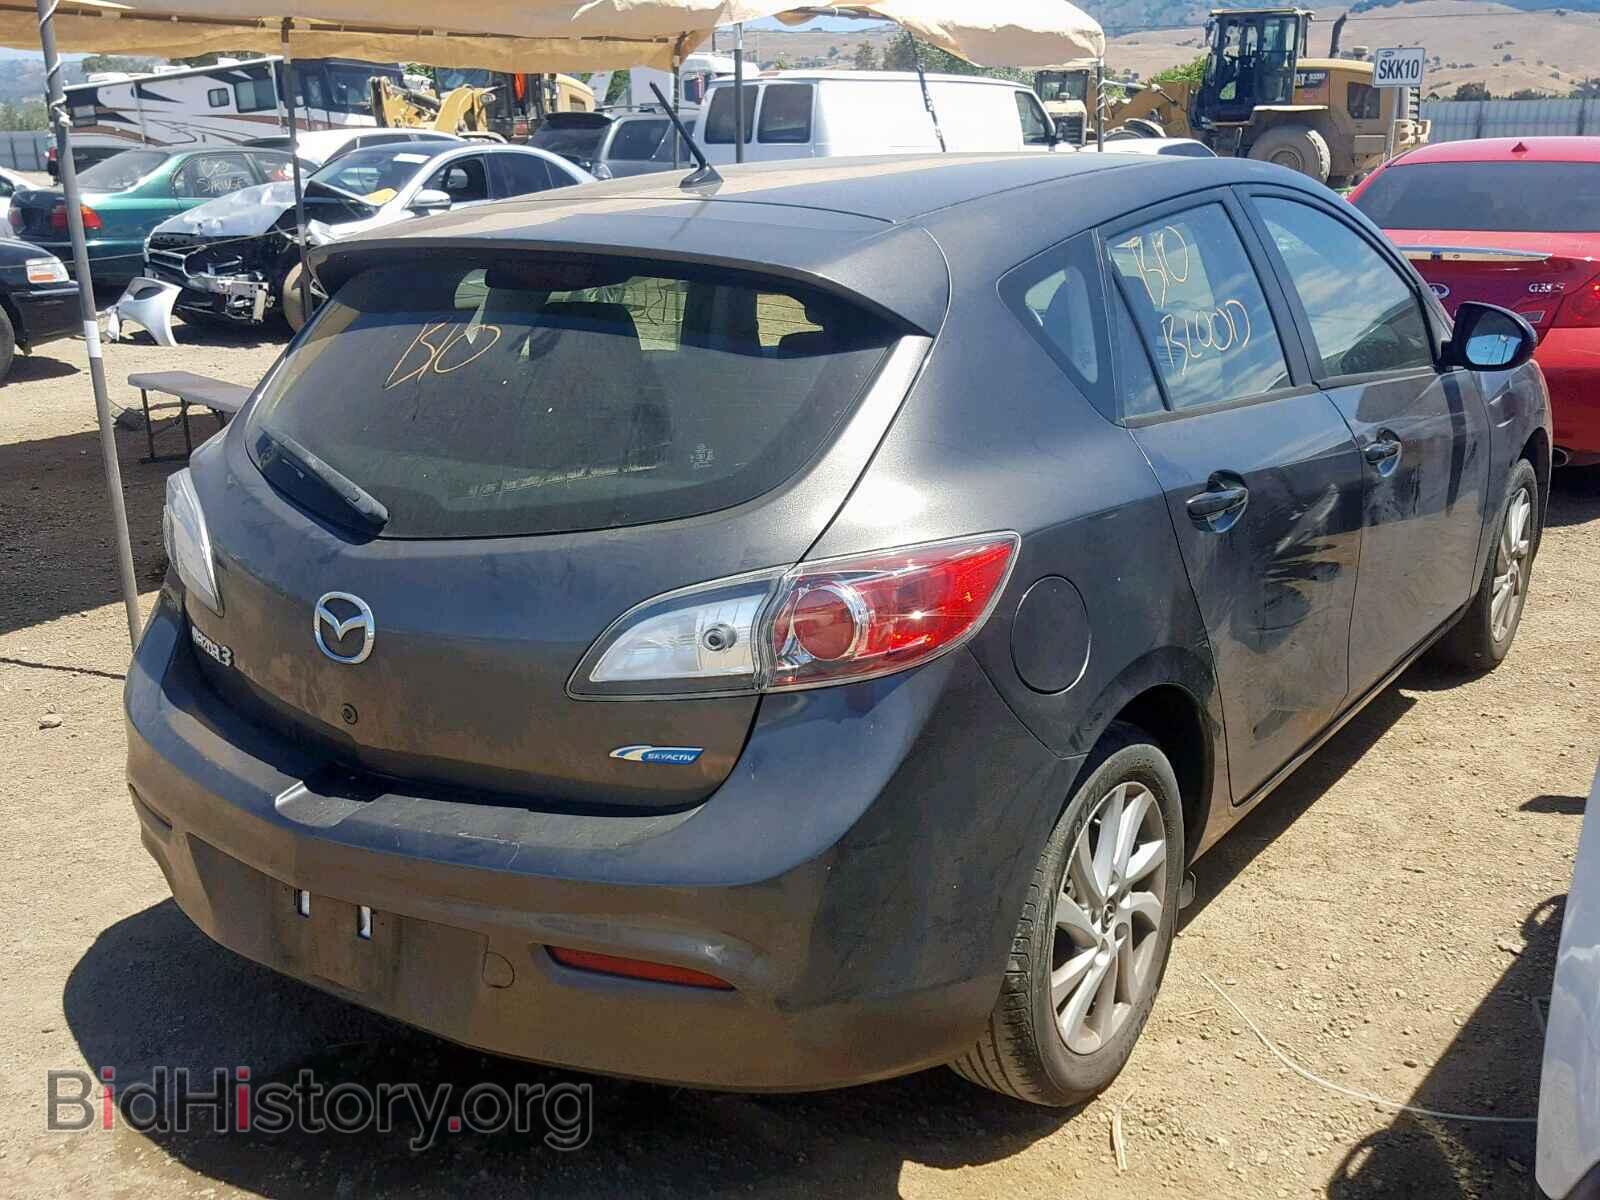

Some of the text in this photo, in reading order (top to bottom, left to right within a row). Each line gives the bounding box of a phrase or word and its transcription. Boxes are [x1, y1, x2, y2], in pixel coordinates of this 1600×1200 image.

[1378, 59, 1420, 80] SKK10
[1160, 299, 1251, 376] BLOOD
[647, 752, 697, 761] SKYACTIV
